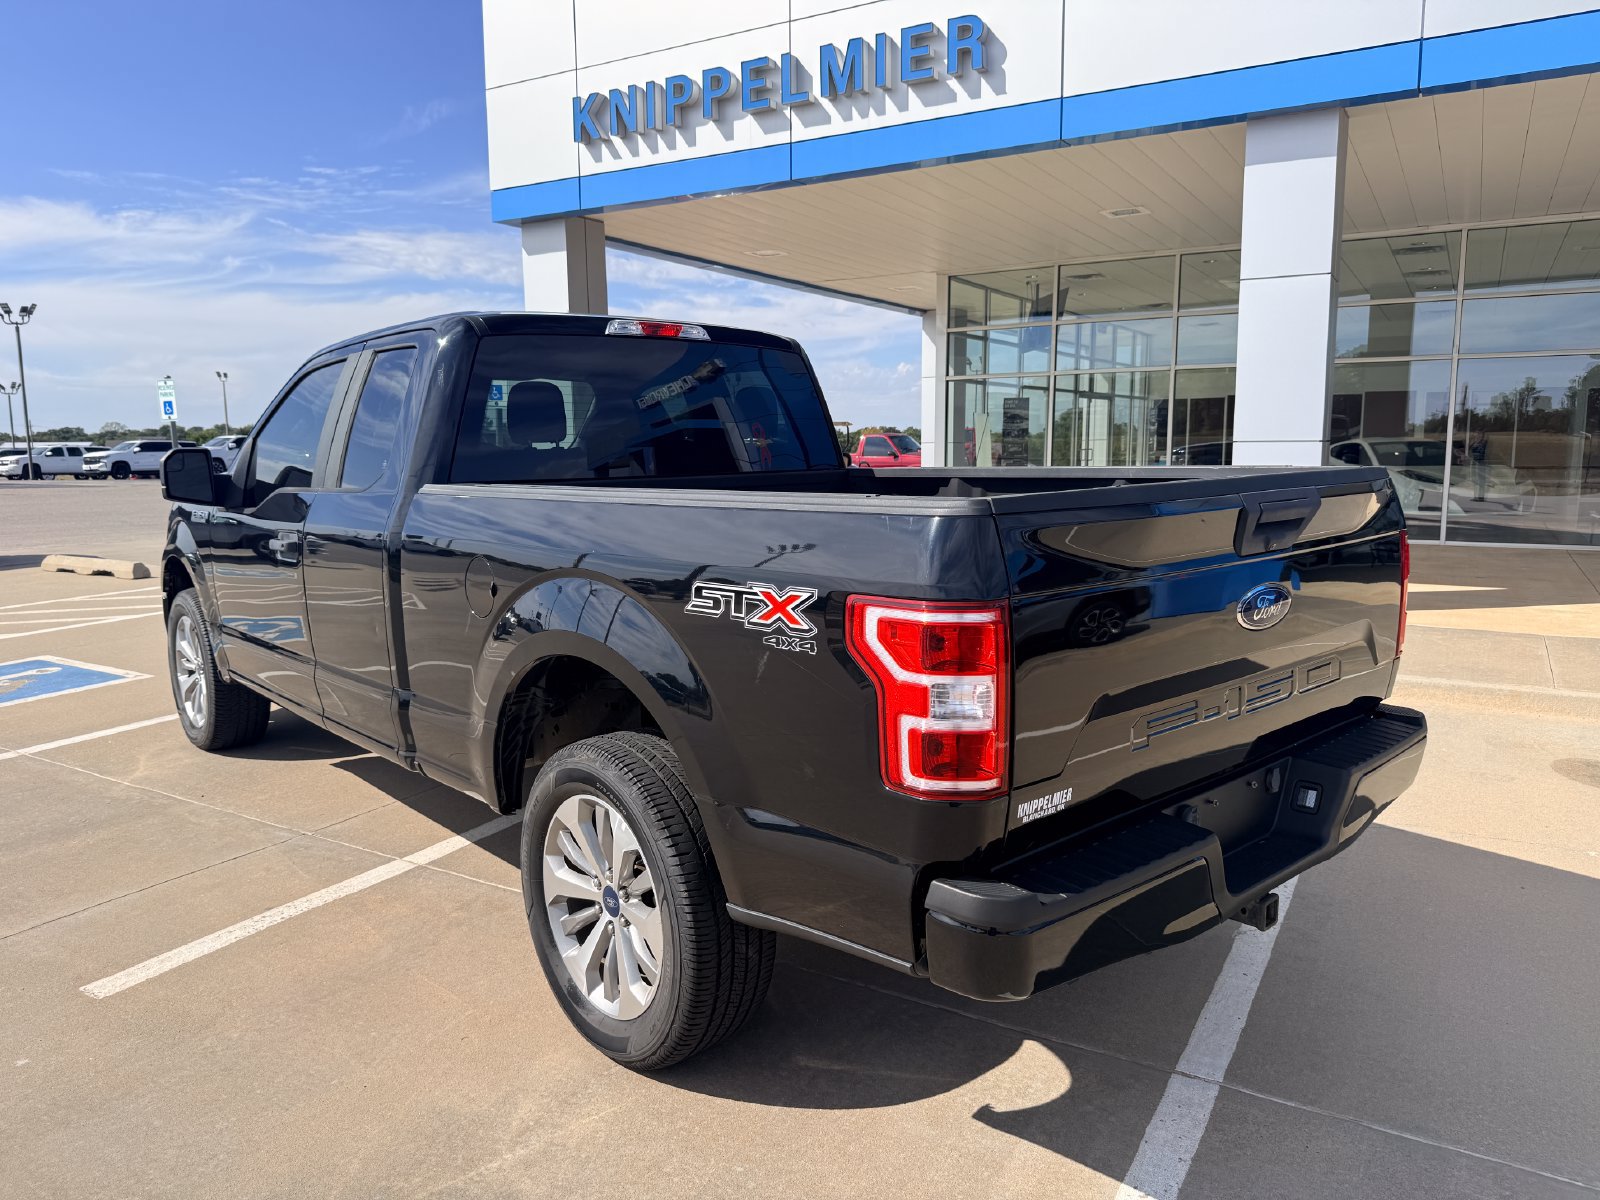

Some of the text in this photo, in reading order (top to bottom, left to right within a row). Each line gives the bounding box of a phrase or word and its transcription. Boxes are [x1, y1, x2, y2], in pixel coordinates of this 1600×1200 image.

[572, 14, 990, 144] KNIPPELMIER
[684, 580, 818, 637] STX
[1131, 655, 1341, 752] F-150
[1017, 787, 1073, 819] KNIPPELMIER
